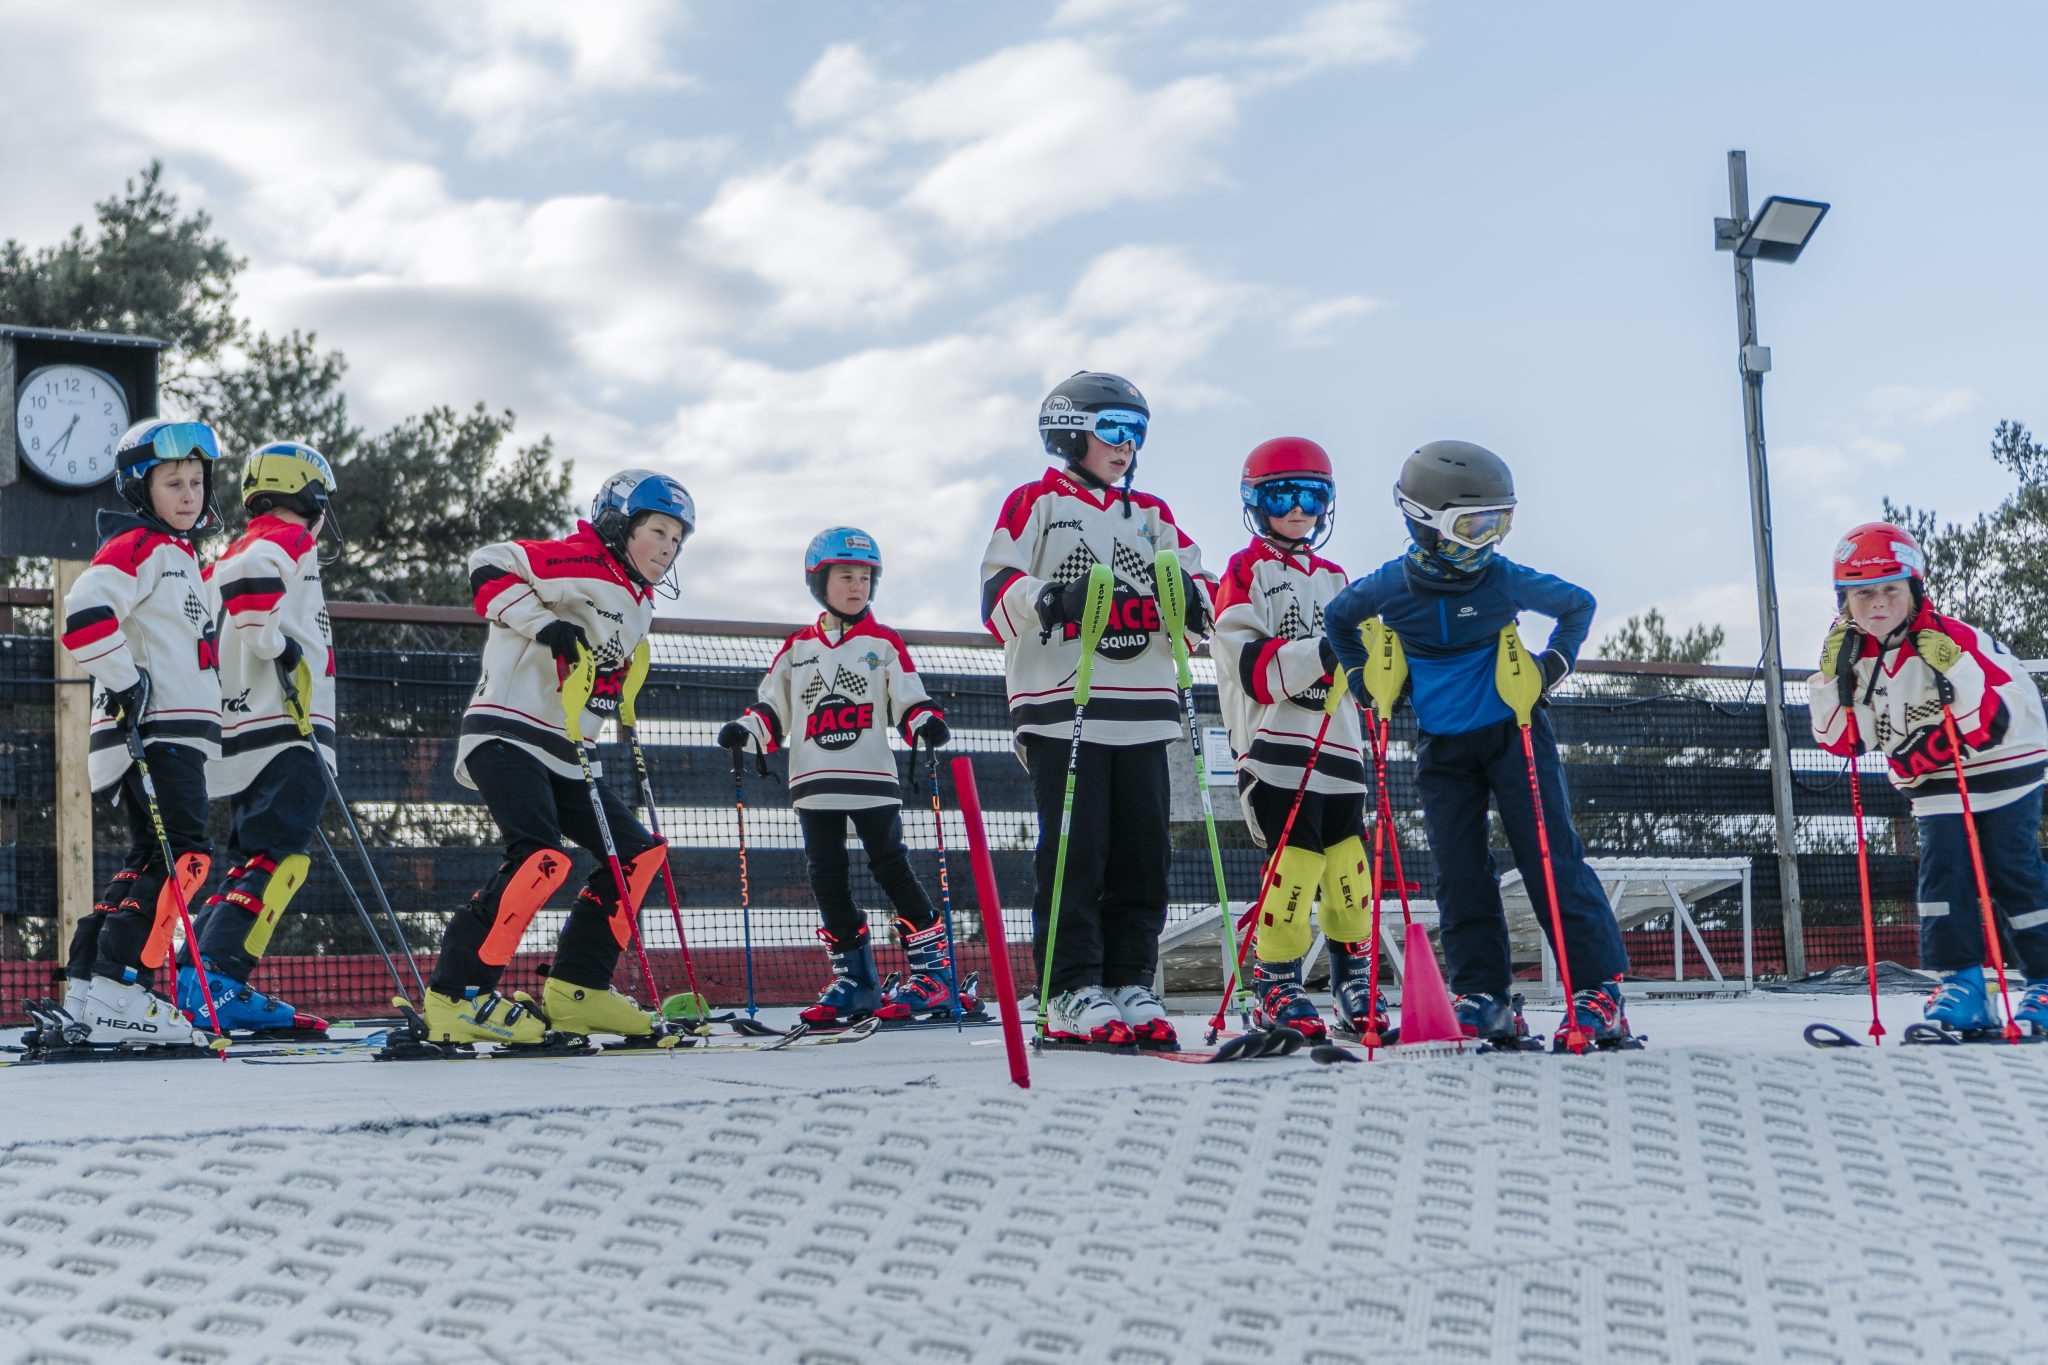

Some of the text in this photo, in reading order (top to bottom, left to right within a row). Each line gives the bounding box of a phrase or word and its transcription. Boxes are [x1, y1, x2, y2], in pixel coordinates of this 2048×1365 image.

[46, 381, 59, 396] 11
[64, 377, 80, 392] 12
[91, 386, 96, 400] 1
[31, 395, 47, 410] 10
[103, 402, 112, 416] 2
[24, 415, 33, 429] 9
[110, 423, 119, 437] 3
[31, 437, 40, 451] 8
[103, 444, 112, 456] 4
[67, 460, 77, 474] 6
[88, 456, 97, 471] 5
[1057, 478, 1078, 495] rhino
[1100, 633, 1147, 650] SQUAD
[1383, 628, 1393, 671] LEKI
[1506, 633, 1521, 676] LEKI
[583, 657, 593, 693] LEKI
[1295, 687, 1328, 700] SQUA
[590, 697, 617, 710] SQU
[804, 703, 874, 741] RACE
[821, 732, 857, 745] SQUAD
[149, 803, 168, 841] LEKI
[1338, 875, 1354, 910] LEKI
[1283, 885, 1303, 924] LEKI
[212, 988, 236, 1011] RACE
[96, 1016, 158, 1034] HEAD
